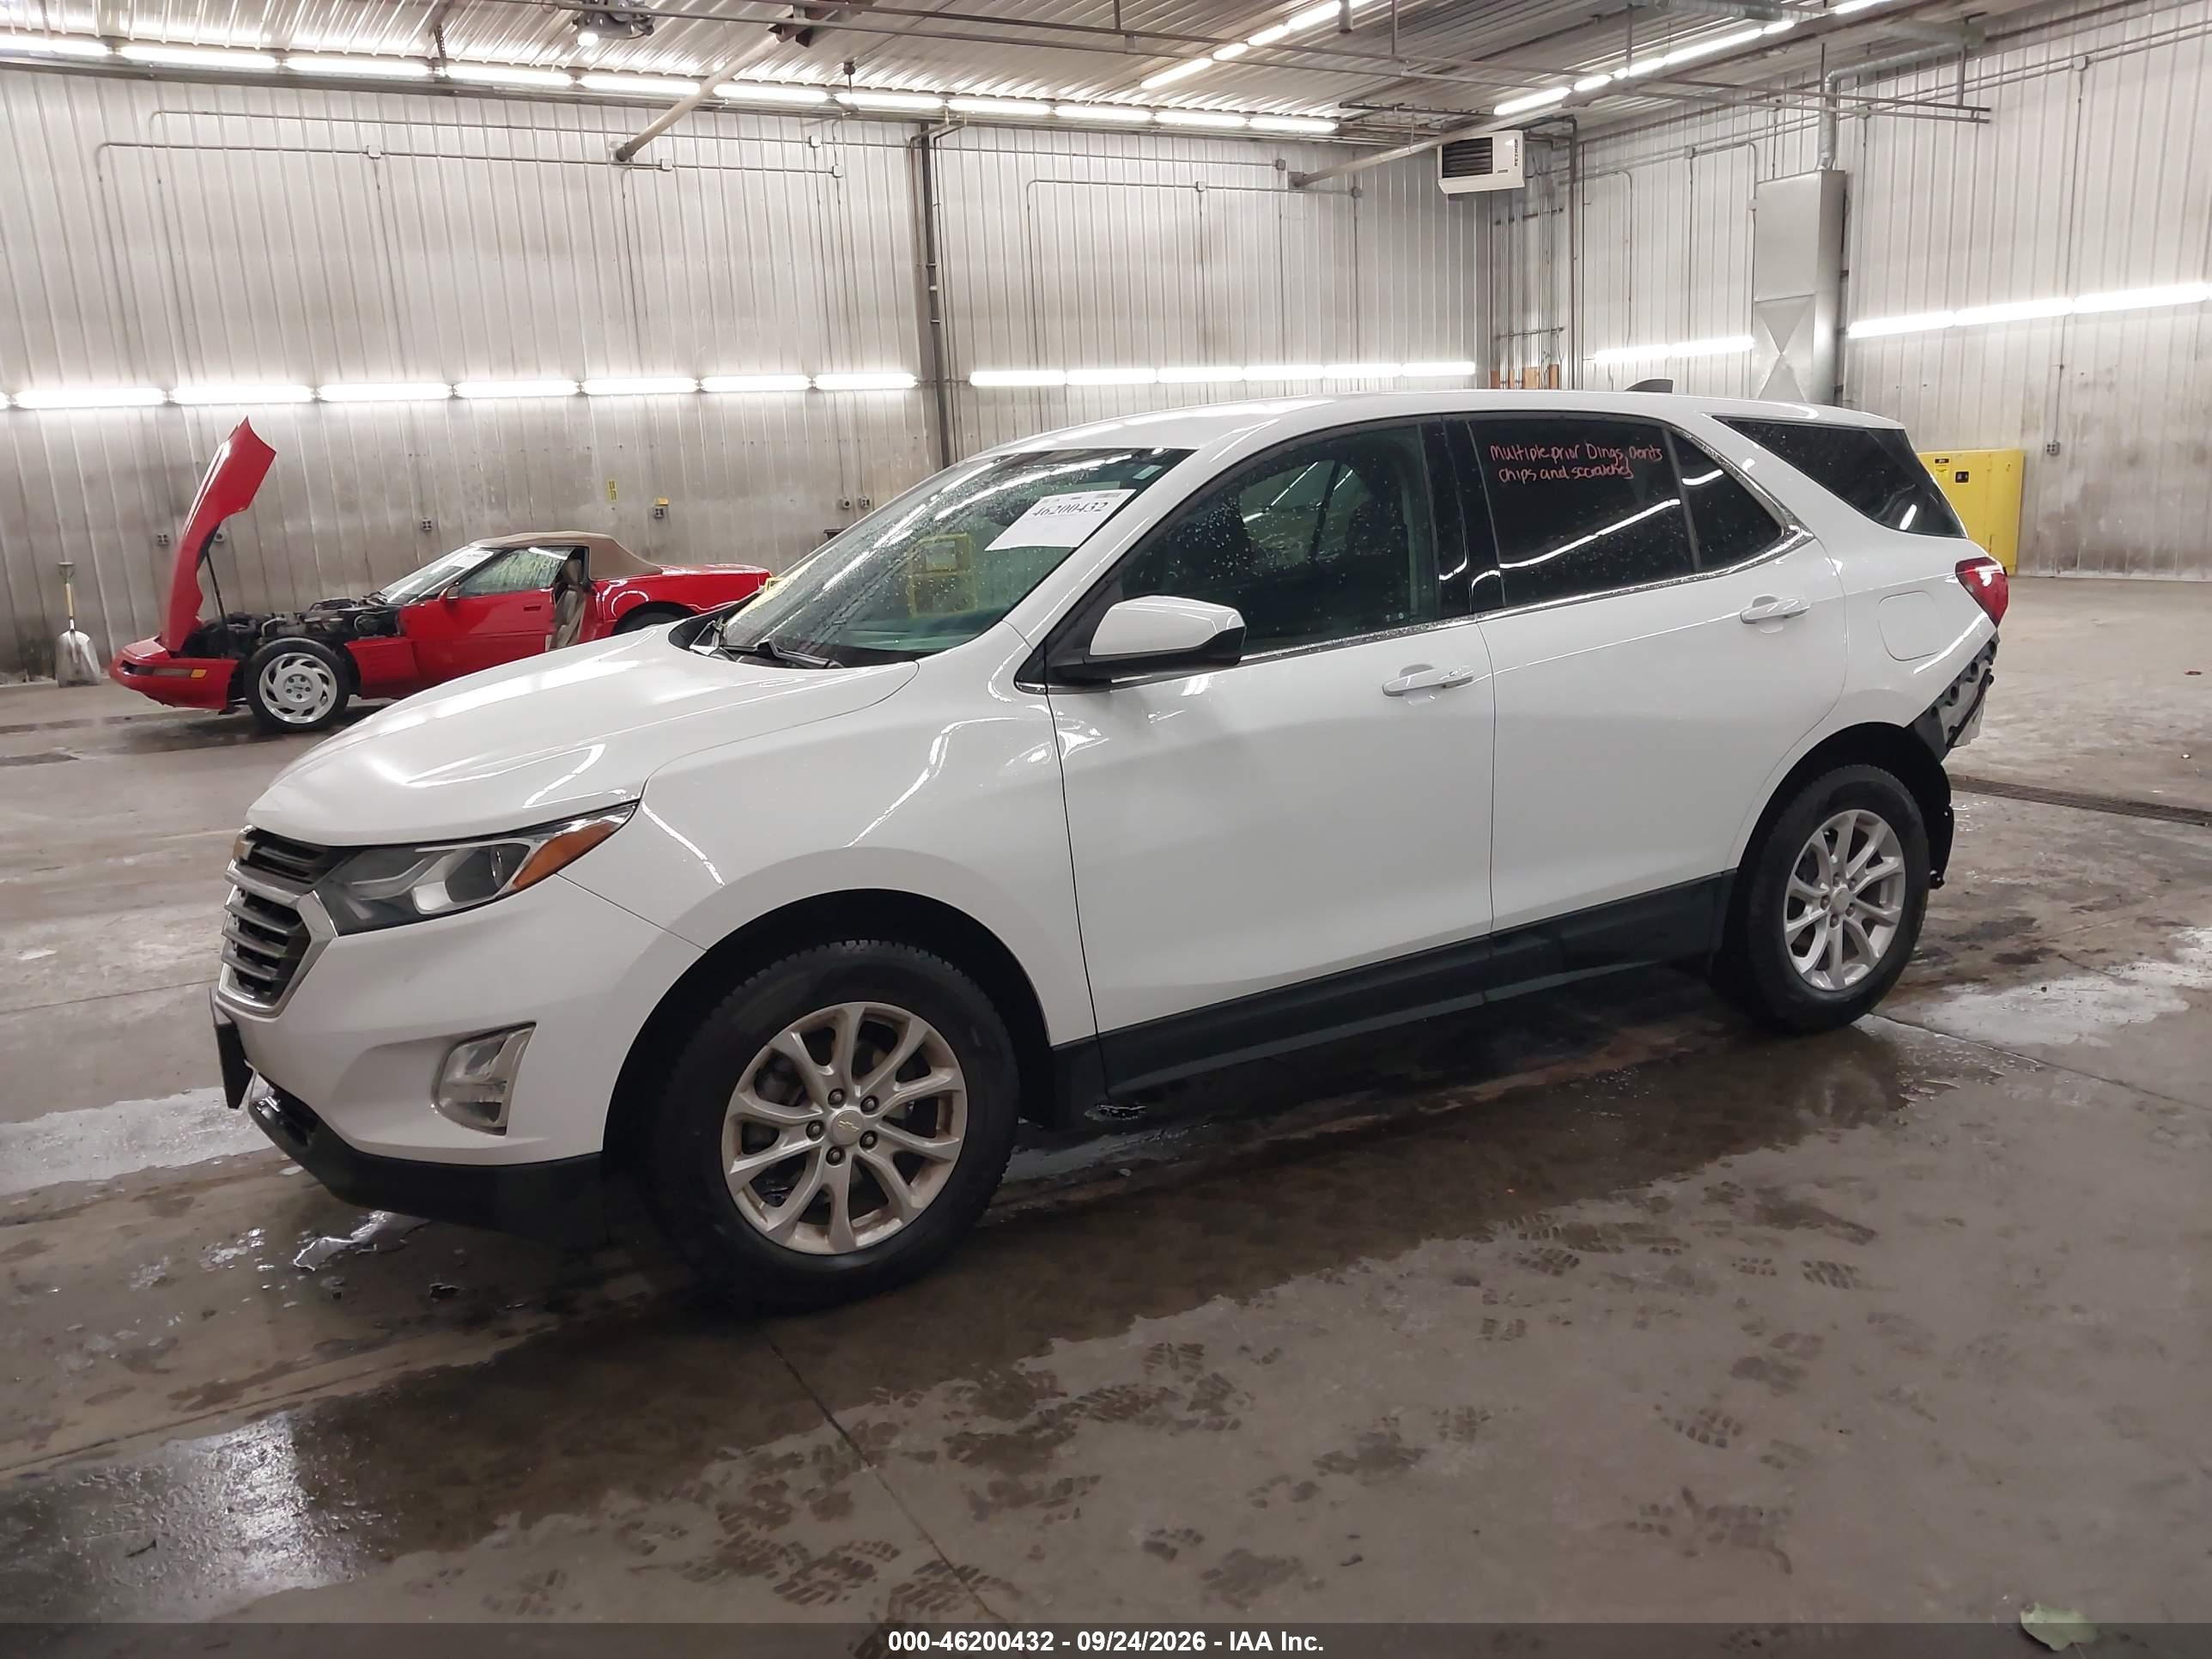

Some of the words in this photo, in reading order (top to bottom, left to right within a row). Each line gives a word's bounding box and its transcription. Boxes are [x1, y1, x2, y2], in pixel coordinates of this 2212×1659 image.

[1490, 444, 1549, 462] Multiple
[1551, 444, 1580, 465] prior
[1498, 467, 1536, 484] chips
[1540, 465, 1570, 480] and
[1032, 501, 1109, 517] 46200432
